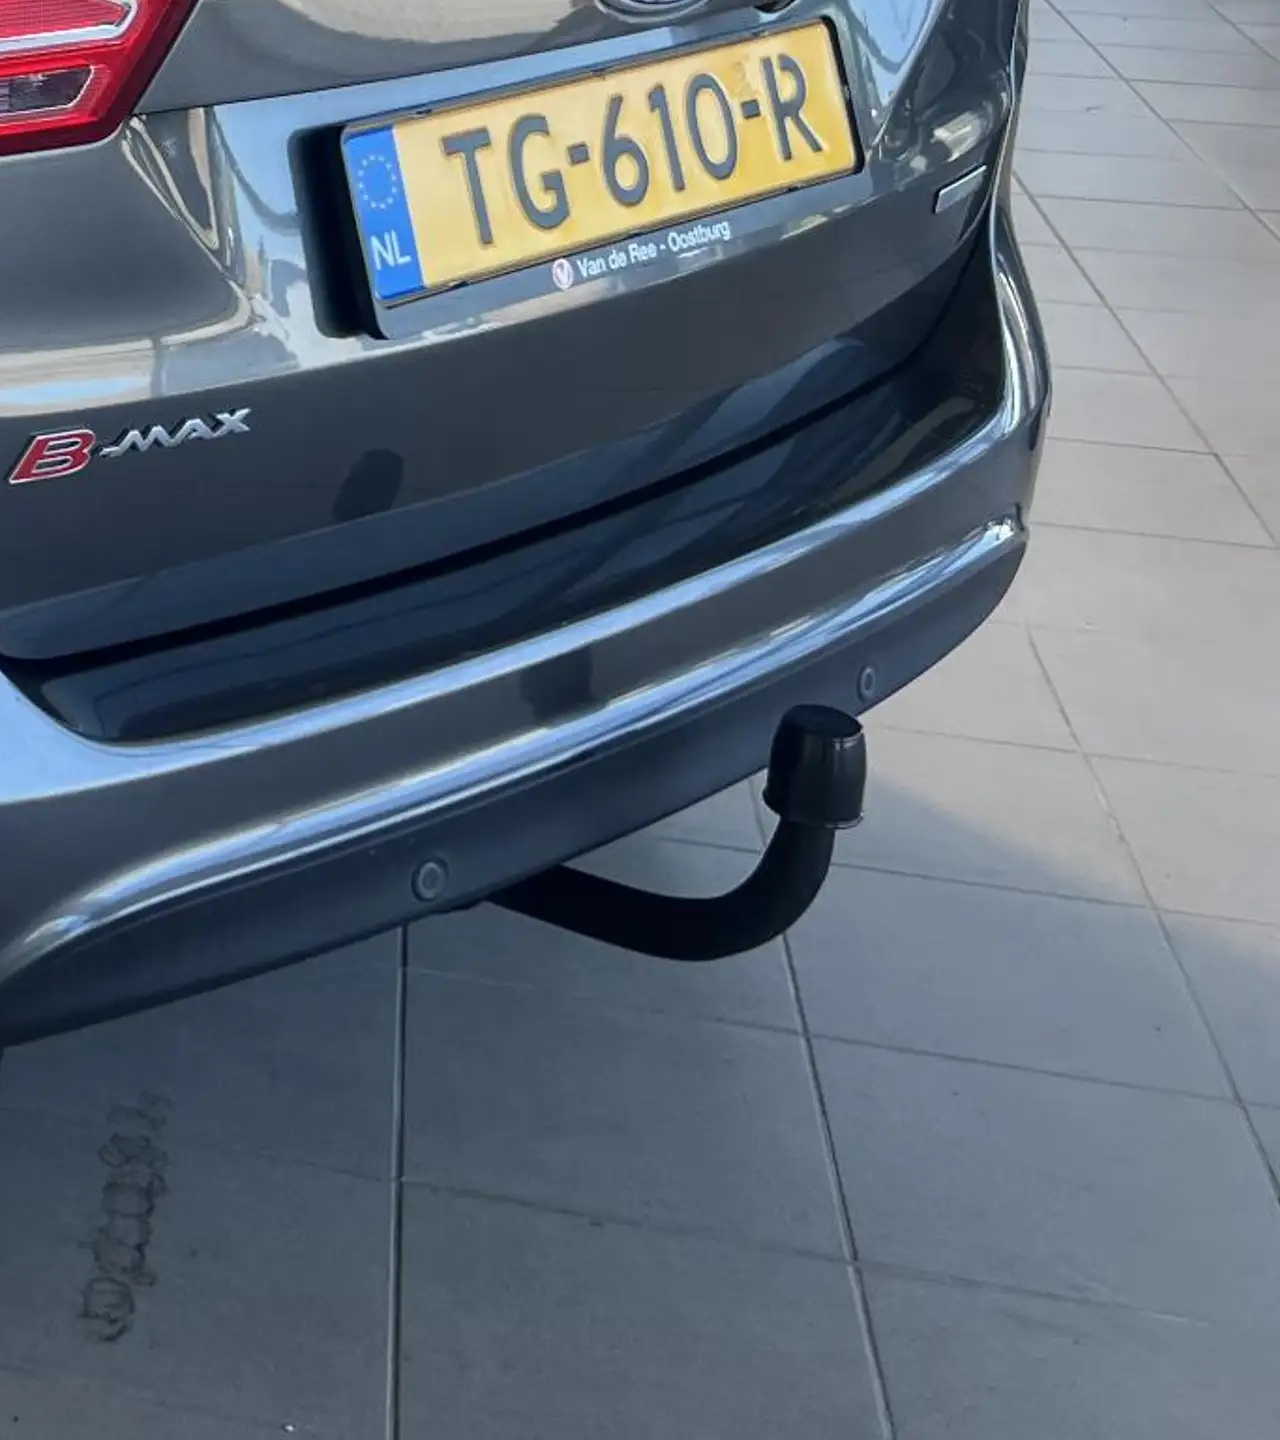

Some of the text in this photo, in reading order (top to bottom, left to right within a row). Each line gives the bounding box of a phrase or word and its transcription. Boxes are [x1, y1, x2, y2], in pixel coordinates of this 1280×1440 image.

[440, 51, 824, 246] TG-610-R
[370, 232, 412, 271] NL
[577, 258, 607, 278] Van
[608, 250, 627, 269] de
[628, 242, 657, 264] Ree
[667, 220, 731, 252] Oostburg
[8, 407, 252, 485] B-MAX
